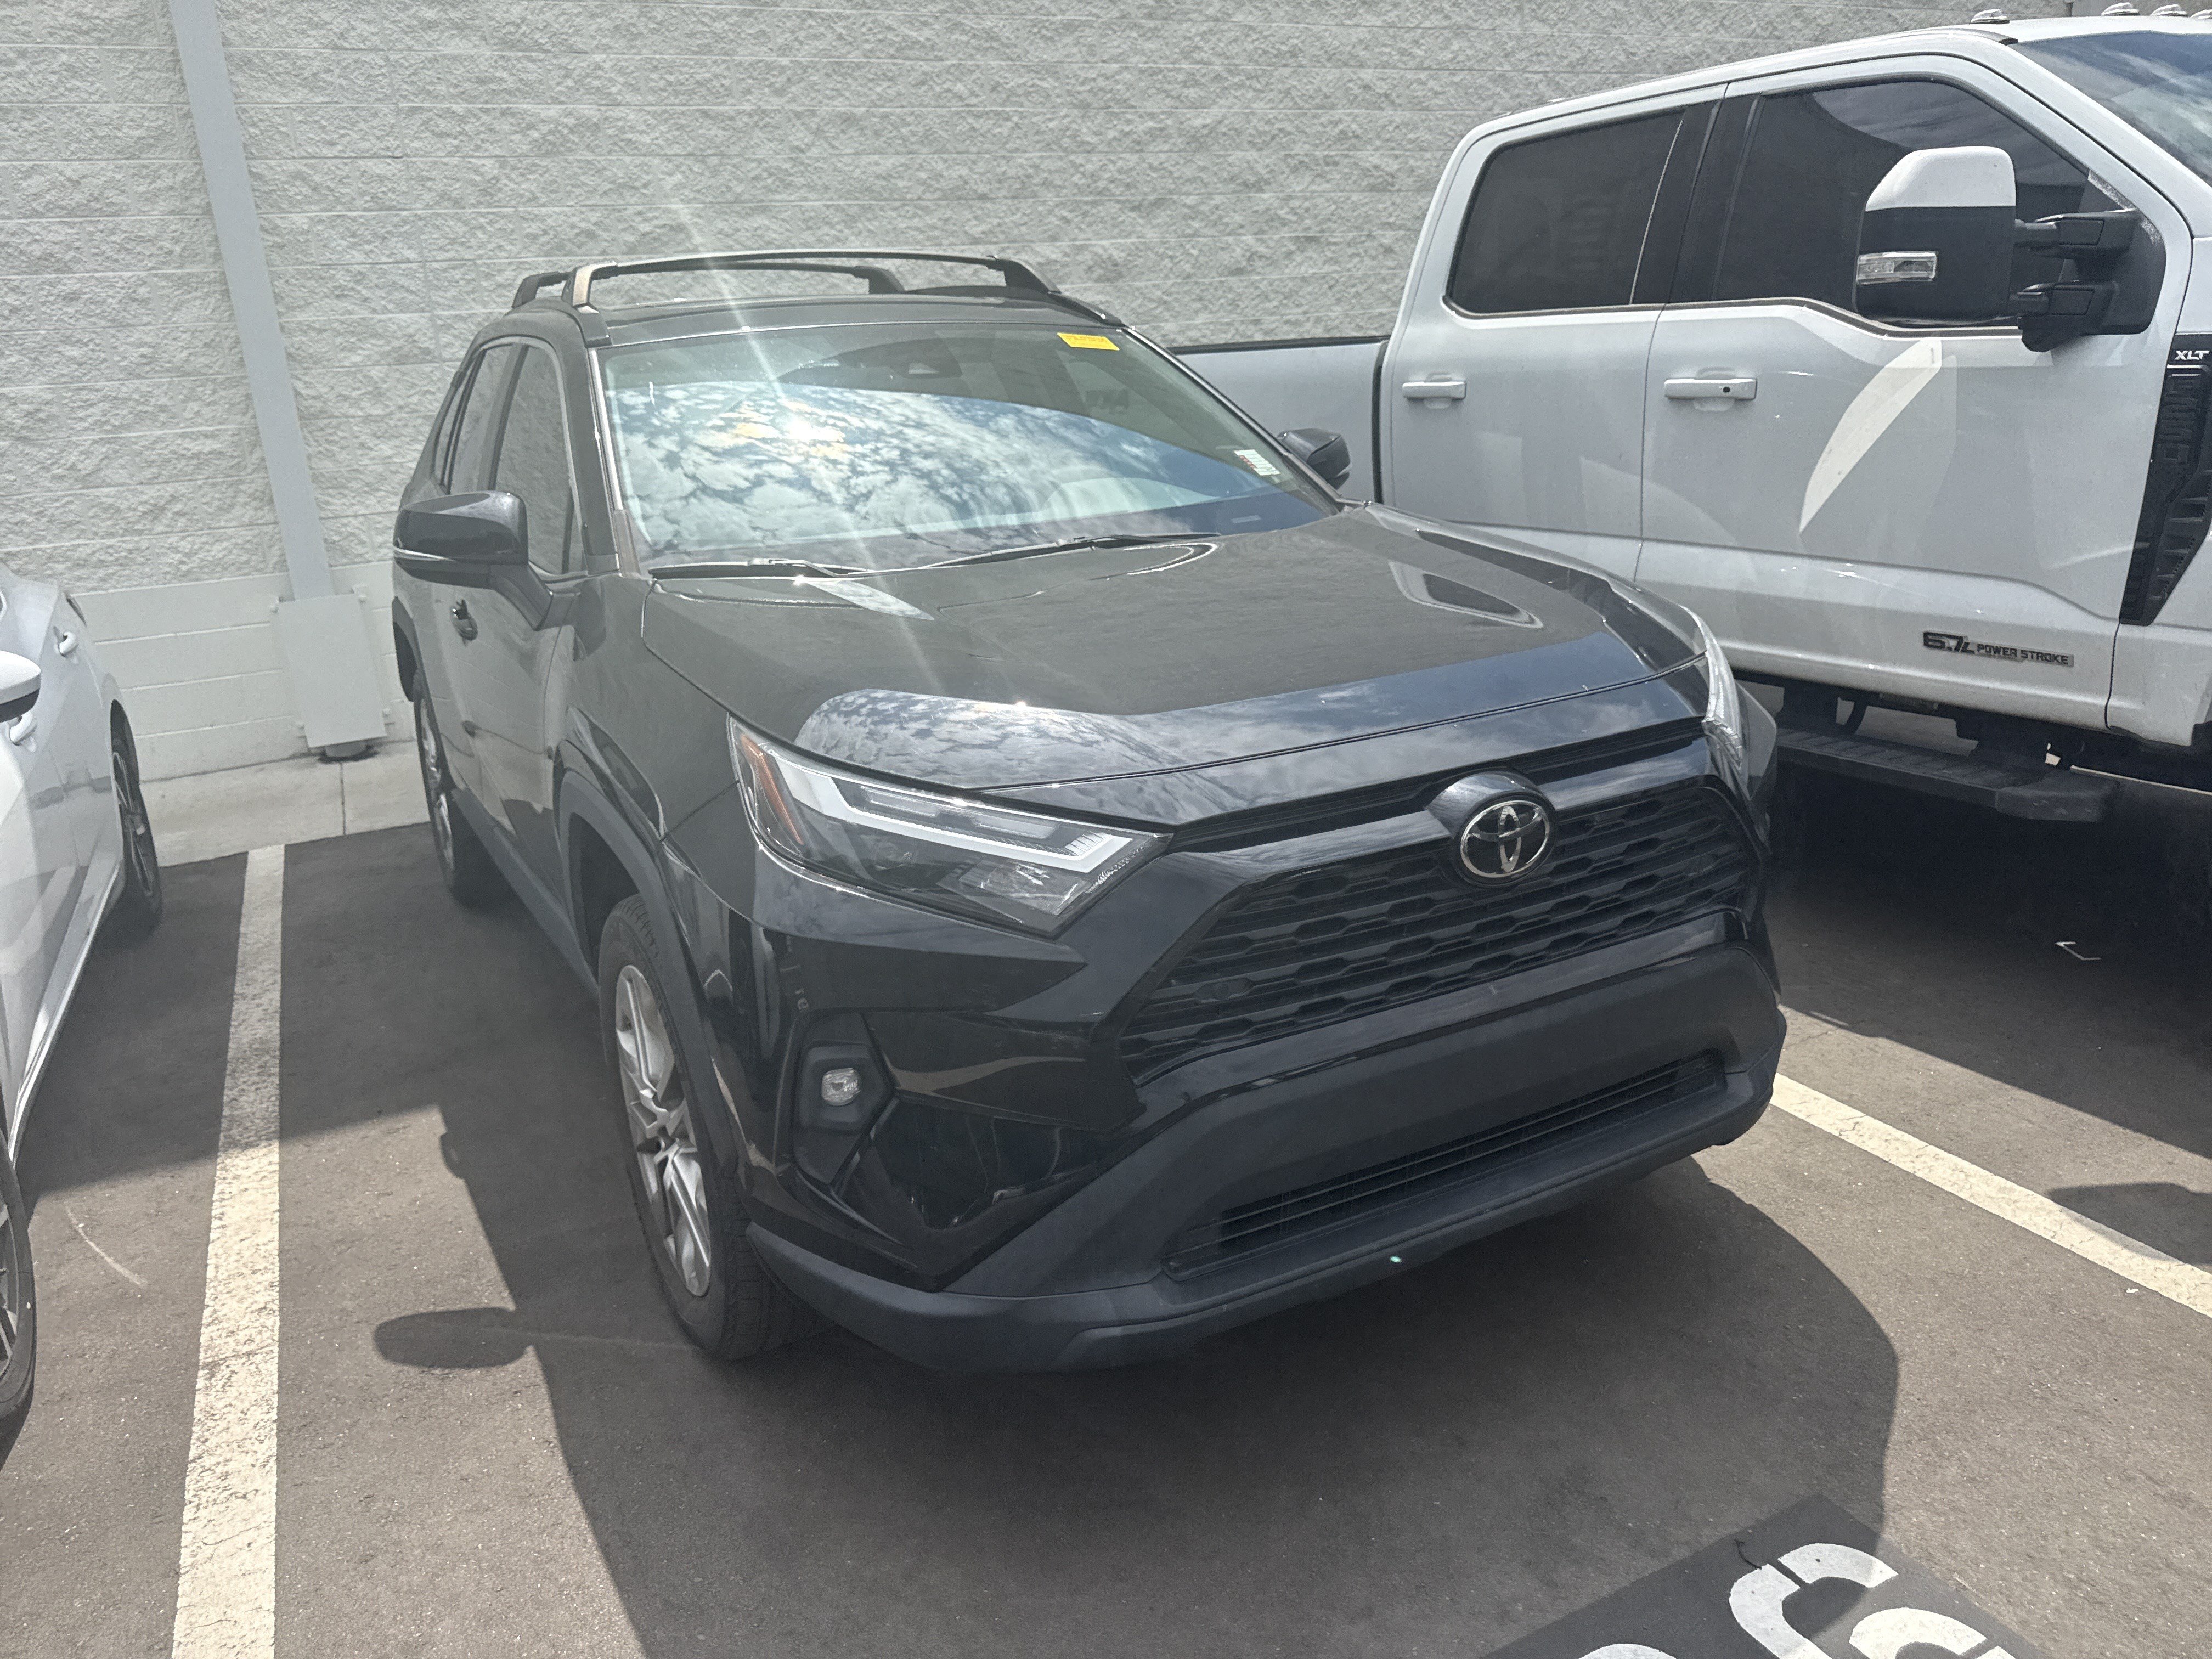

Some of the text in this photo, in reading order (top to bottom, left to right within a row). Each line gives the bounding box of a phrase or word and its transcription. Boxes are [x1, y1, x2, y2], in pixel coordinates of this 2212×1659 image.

[2174, 350, 2209, 360] XLT
[1923, 631, 2069, 665] 6.7L POWER STROKE
